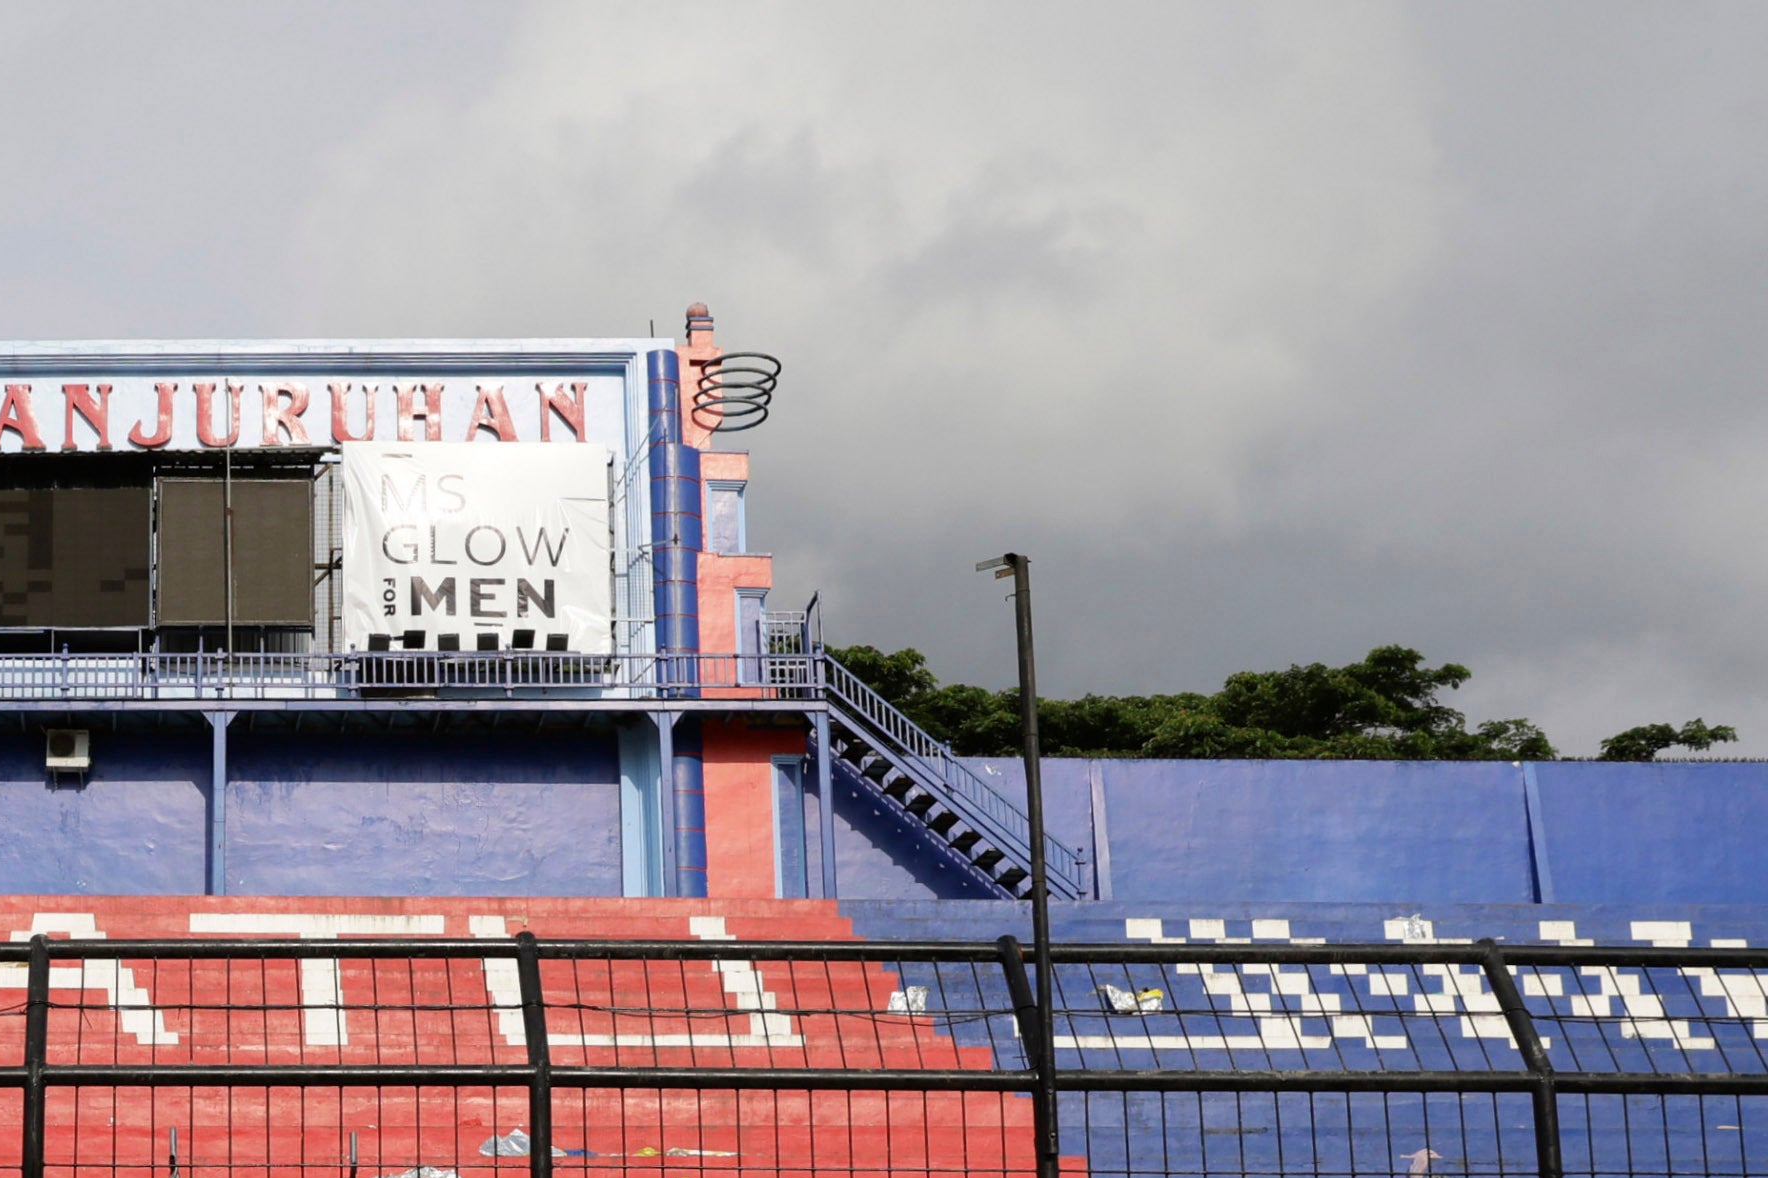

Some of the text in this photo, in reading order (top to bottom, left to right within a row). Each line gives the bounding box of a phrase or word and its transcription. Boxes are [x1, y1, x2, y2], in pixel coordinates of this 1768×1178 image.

[382, 474, 465, 513] MS
[383, 524, 570, 567] GLOW
[383, 578, 396, 617] FOR
[410, 577, 556, 618] MEN
